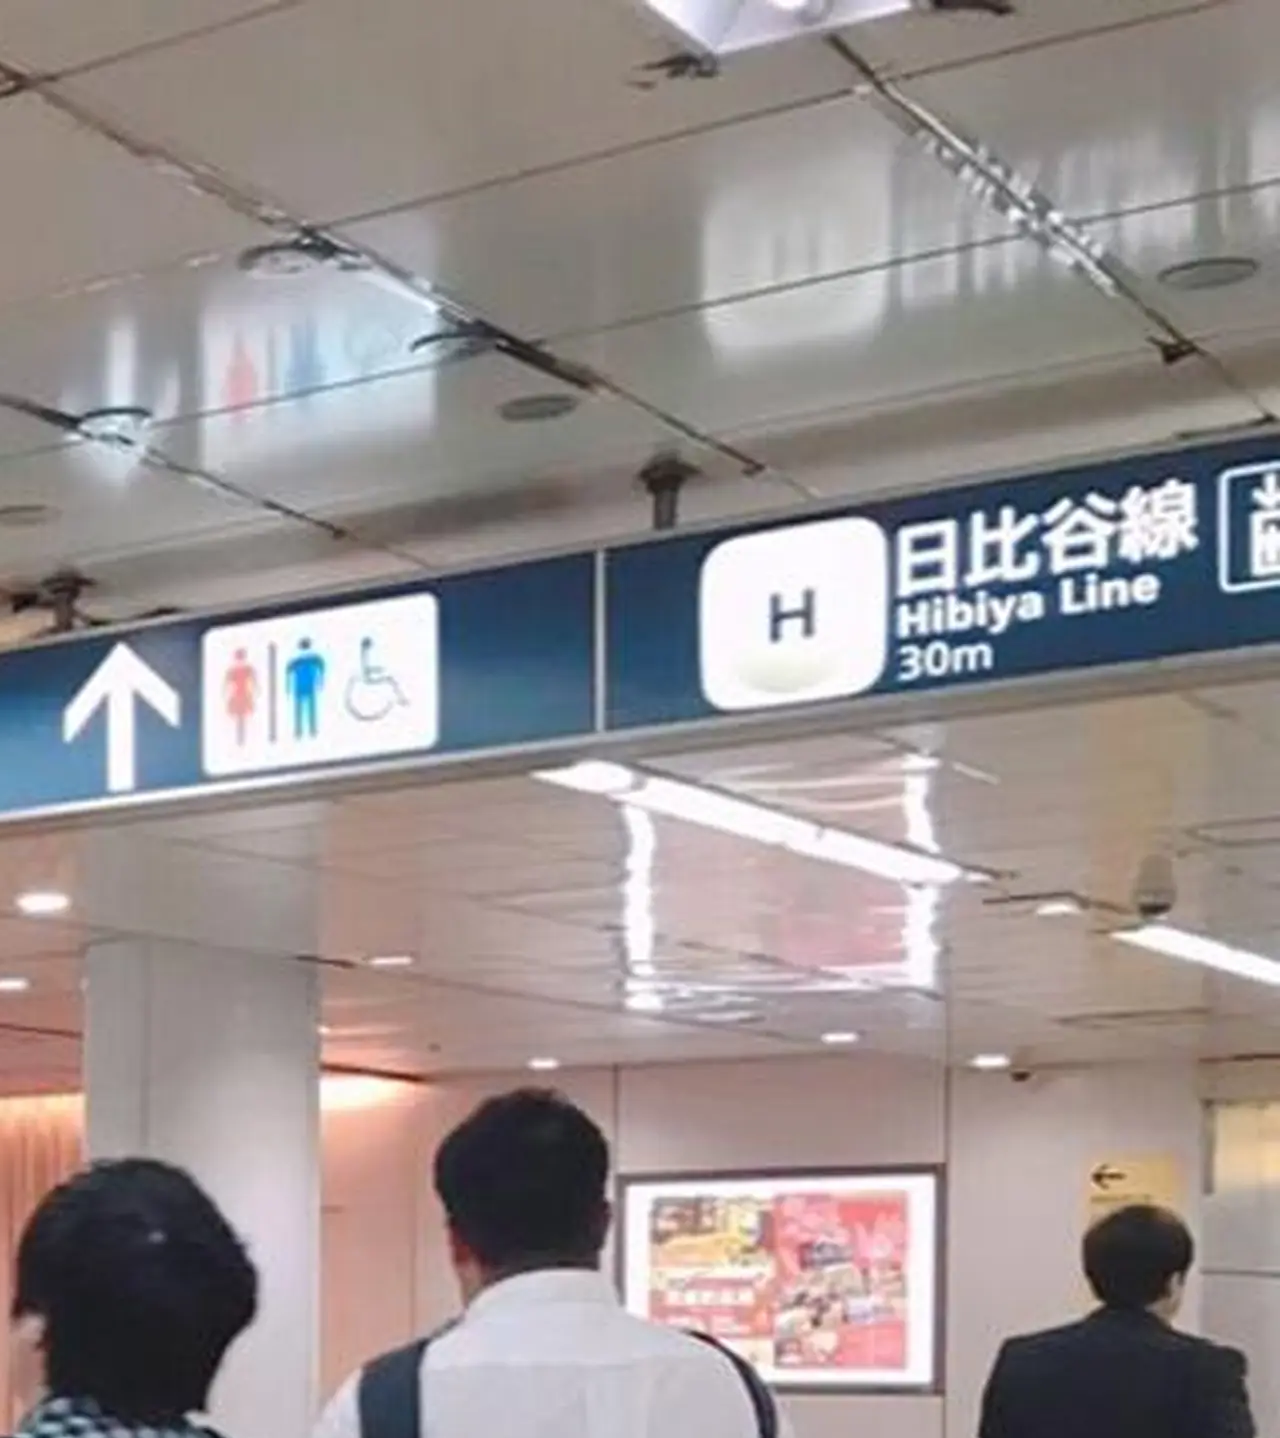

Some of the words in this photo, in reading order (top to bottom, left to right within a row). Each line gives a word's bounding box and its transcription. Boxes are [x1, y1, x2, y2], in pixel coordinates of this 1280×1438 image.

[896, 480, 1199, 597] 日比谷線
[768, 588, 815, 643] H
[896, 590, 1045, 638] Hibiya
[1059, 572, 1161, 615] Line
[897, 641, 993, 682] 30m
